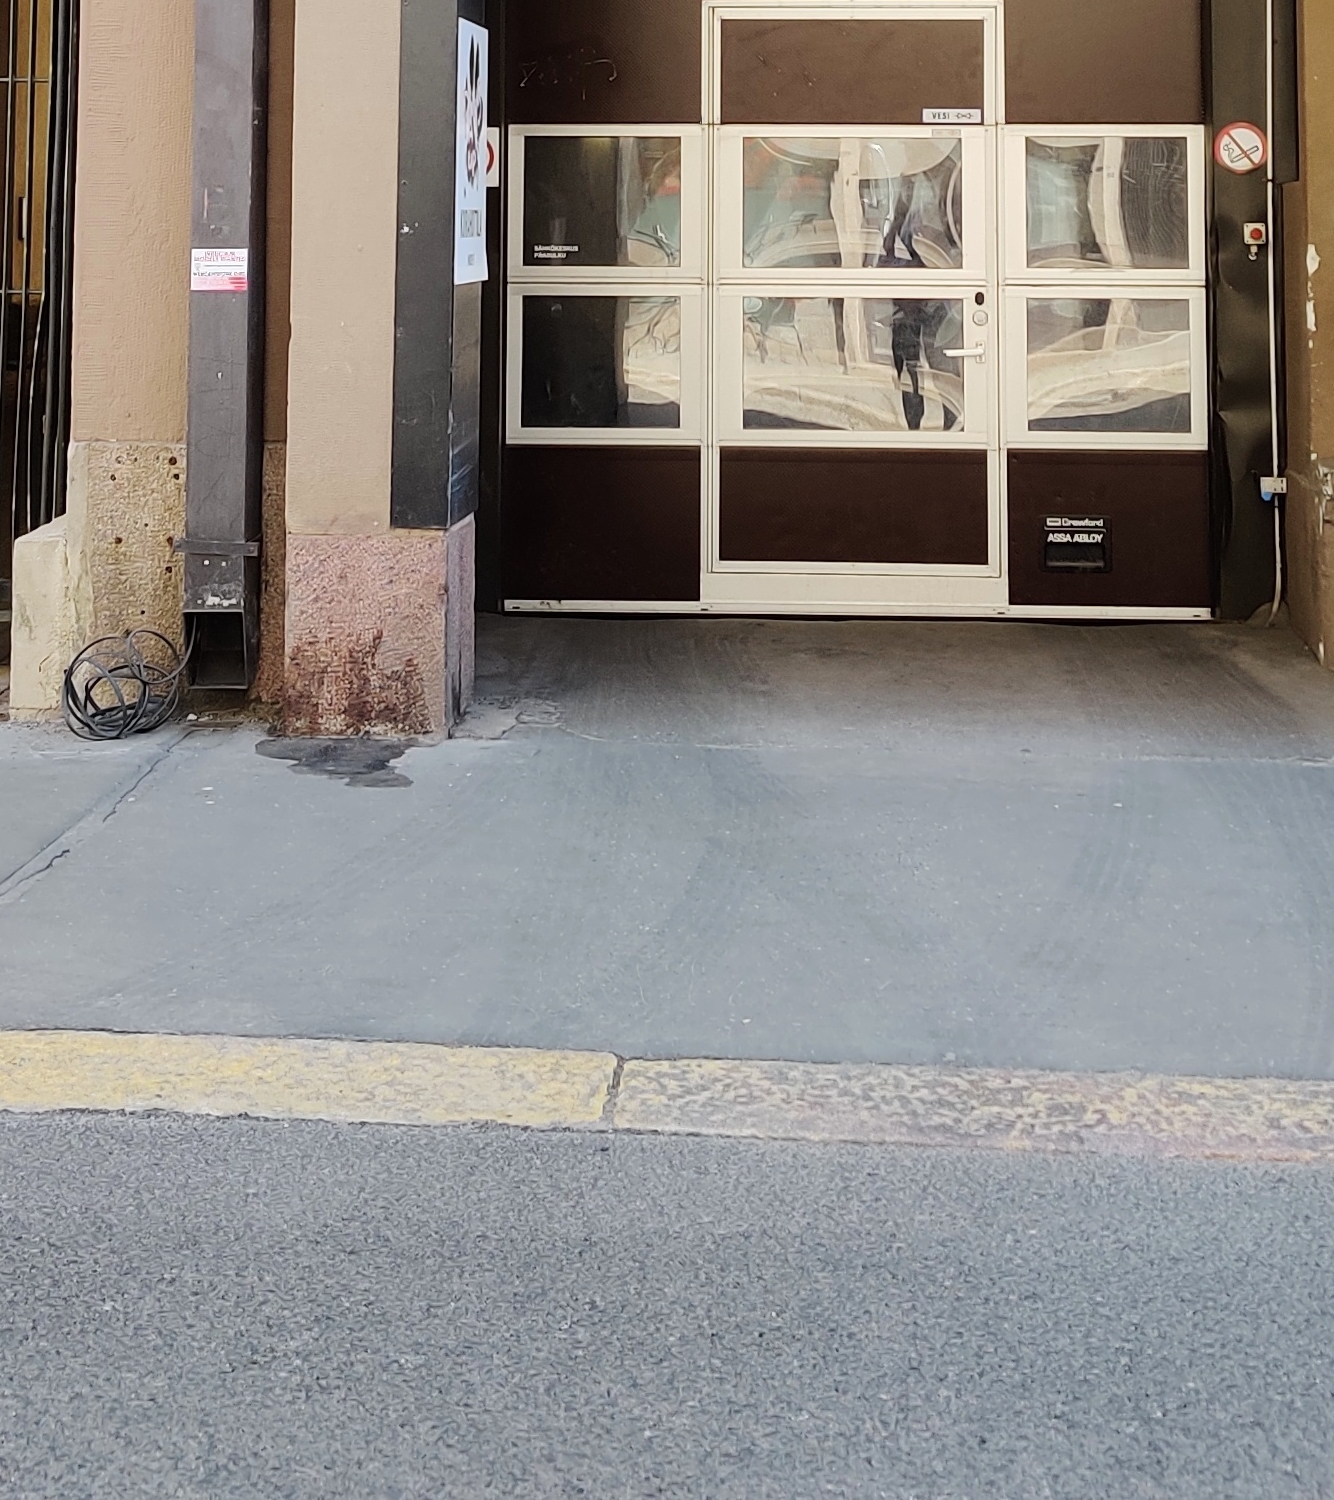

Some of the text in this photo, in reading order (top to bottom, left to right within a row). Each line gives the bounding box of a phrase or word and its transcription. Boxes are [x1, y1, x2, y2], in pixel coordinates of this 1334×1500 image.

[931, 111, 950, 120] VESI
[1047, 532, 1104, 543] ASSA ABLOY
